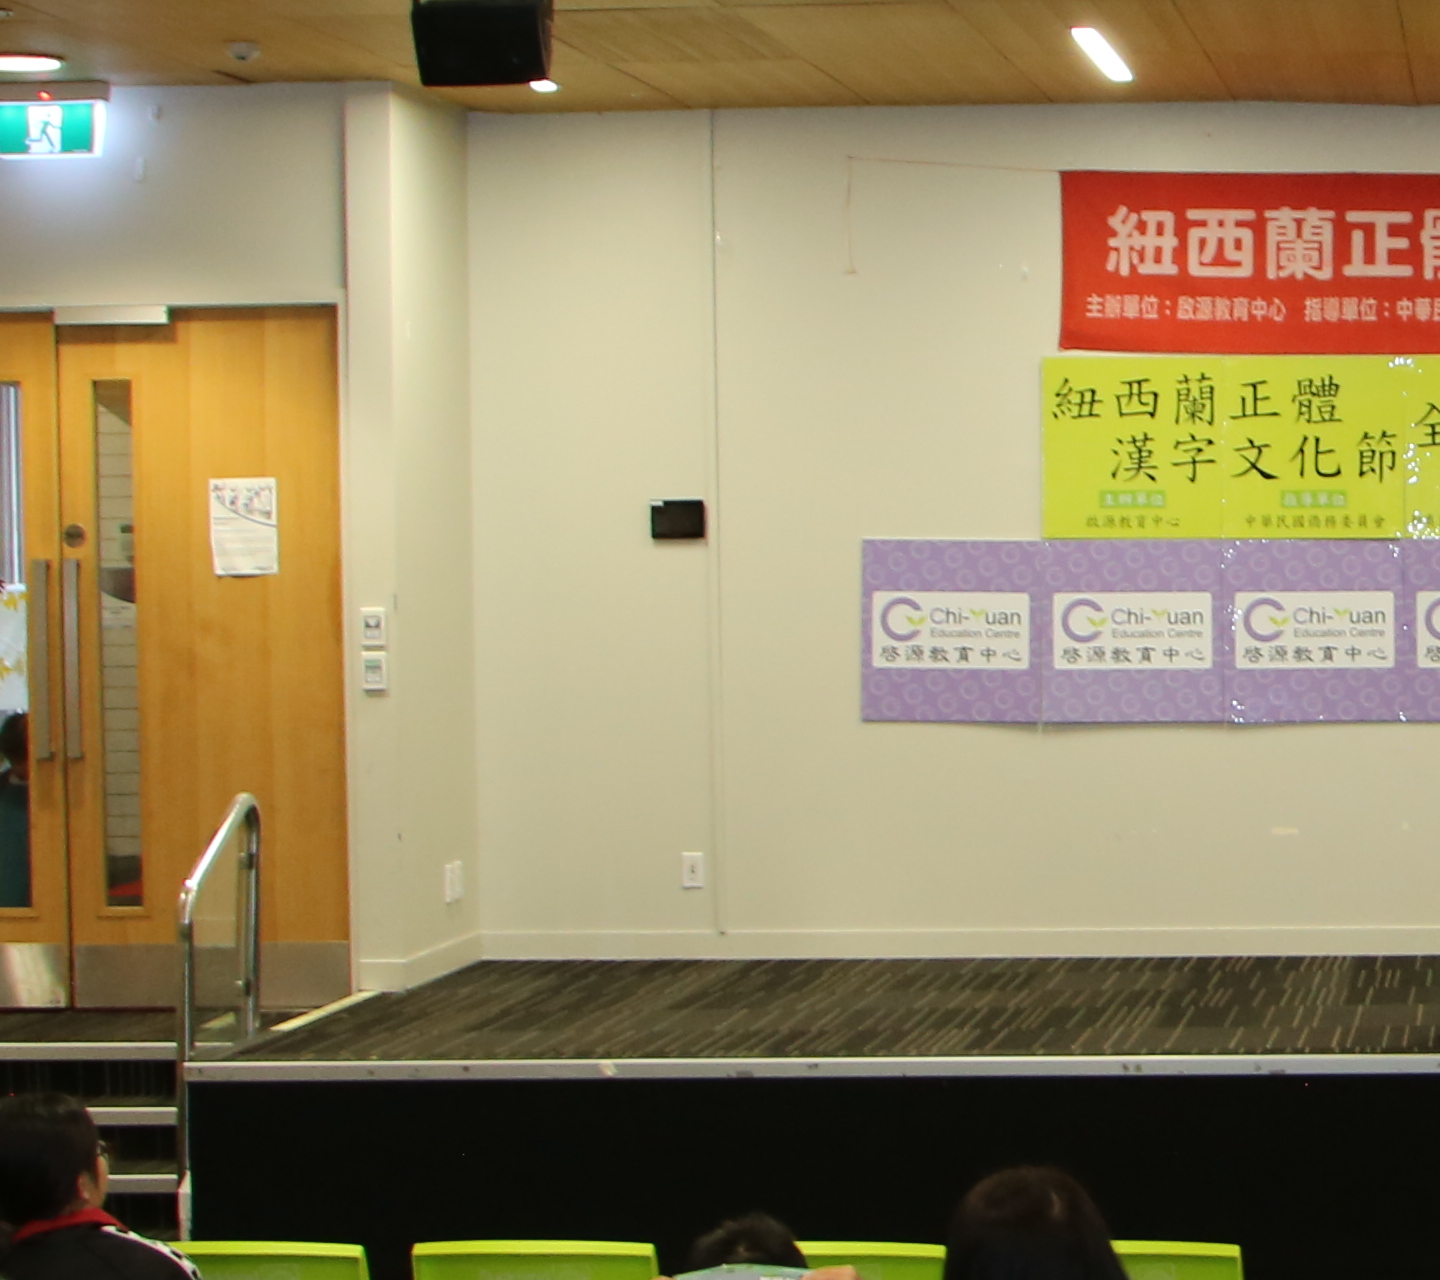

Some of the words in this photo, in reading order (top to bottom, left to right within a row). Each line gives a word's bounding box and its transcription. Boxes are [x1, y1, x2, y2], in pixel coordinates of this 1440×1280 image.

[1052, 372, 1343, 426] 紐西蘭正體
[1110, 430, 1397, 484] 漢字文化節
[930, 628, 982, 639] Education
[985, 628, 1021, 639] Centre
[1112, 628, 1164, 639] Education
[1167, 628, 1204, 639] Centre
[1294, 627, 1346, 638] Education
[1349, 627, 1386, 638] Centre
